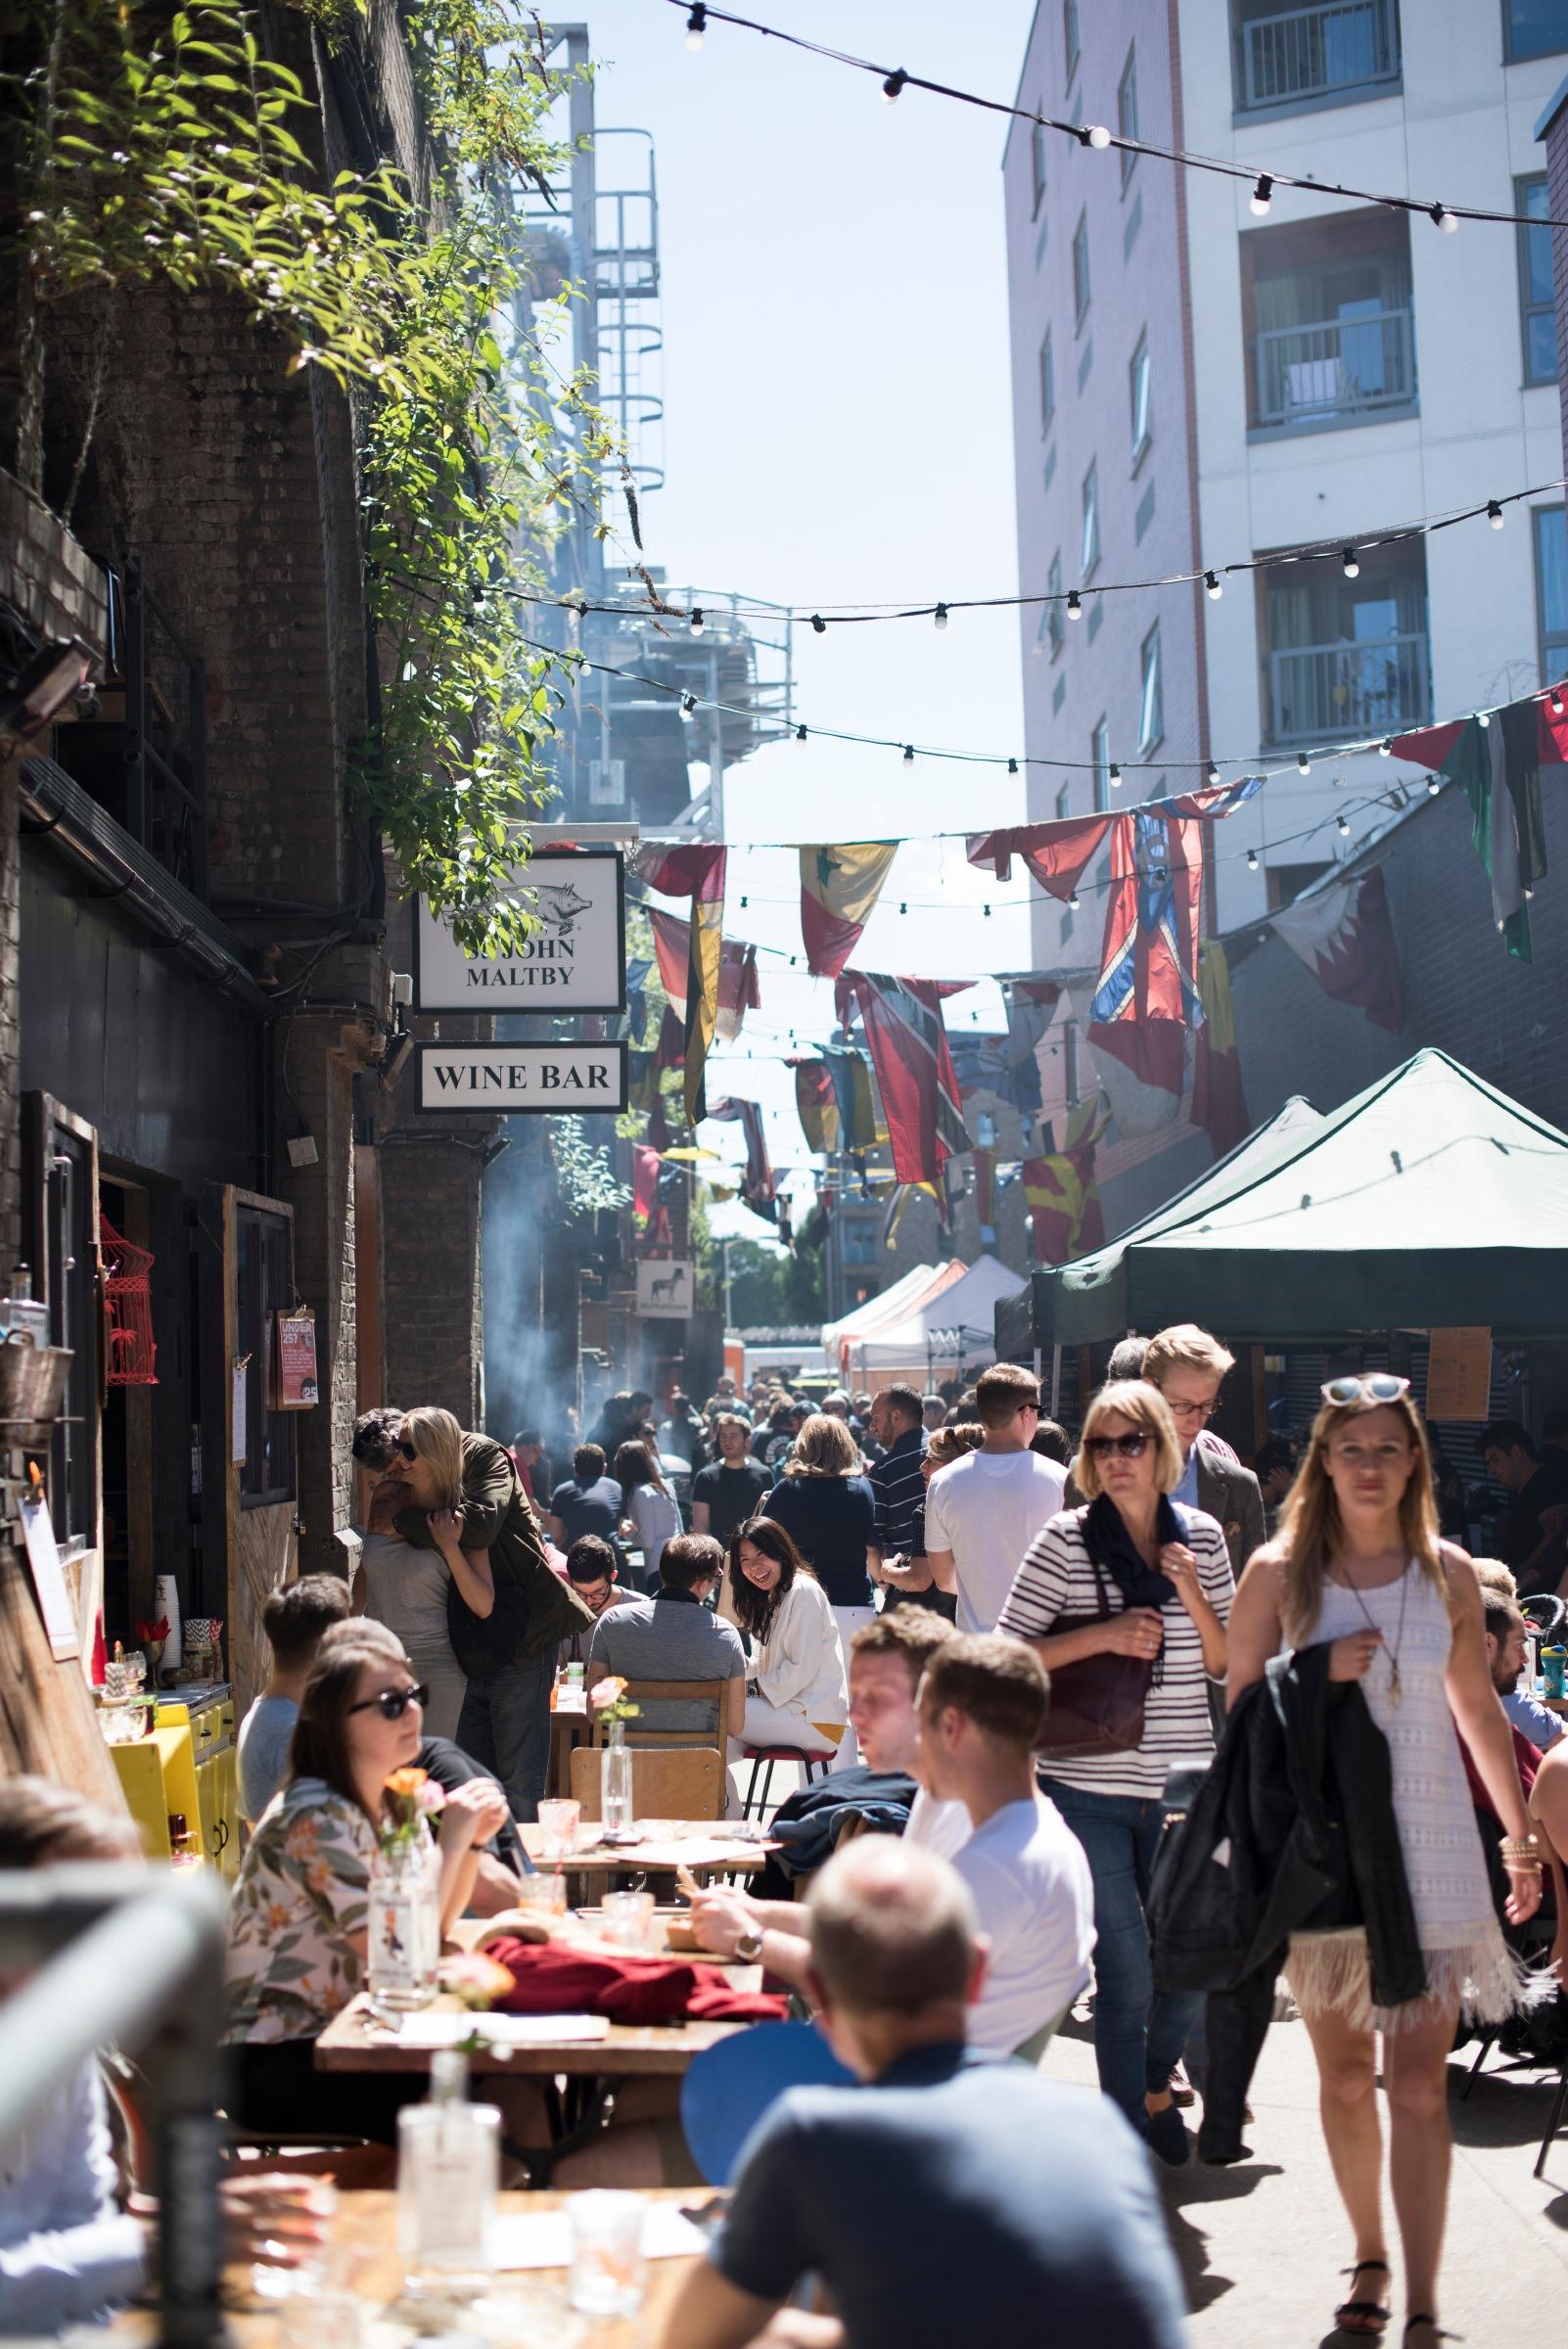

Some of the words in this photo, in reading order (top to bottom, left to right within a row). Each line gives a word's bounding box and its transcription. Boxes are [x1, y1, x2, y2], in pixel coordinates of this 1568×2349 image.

[501, 939, 575, 959] JOHN
[466, 967, 576, 987] MALTBY
[433, 1065, 527, 1090] WINE
[540, 1065, 611, 1088] BAR
[282, 1321, 312, 1333] UNDER
[283, 1333, 298, 1344] 25?
